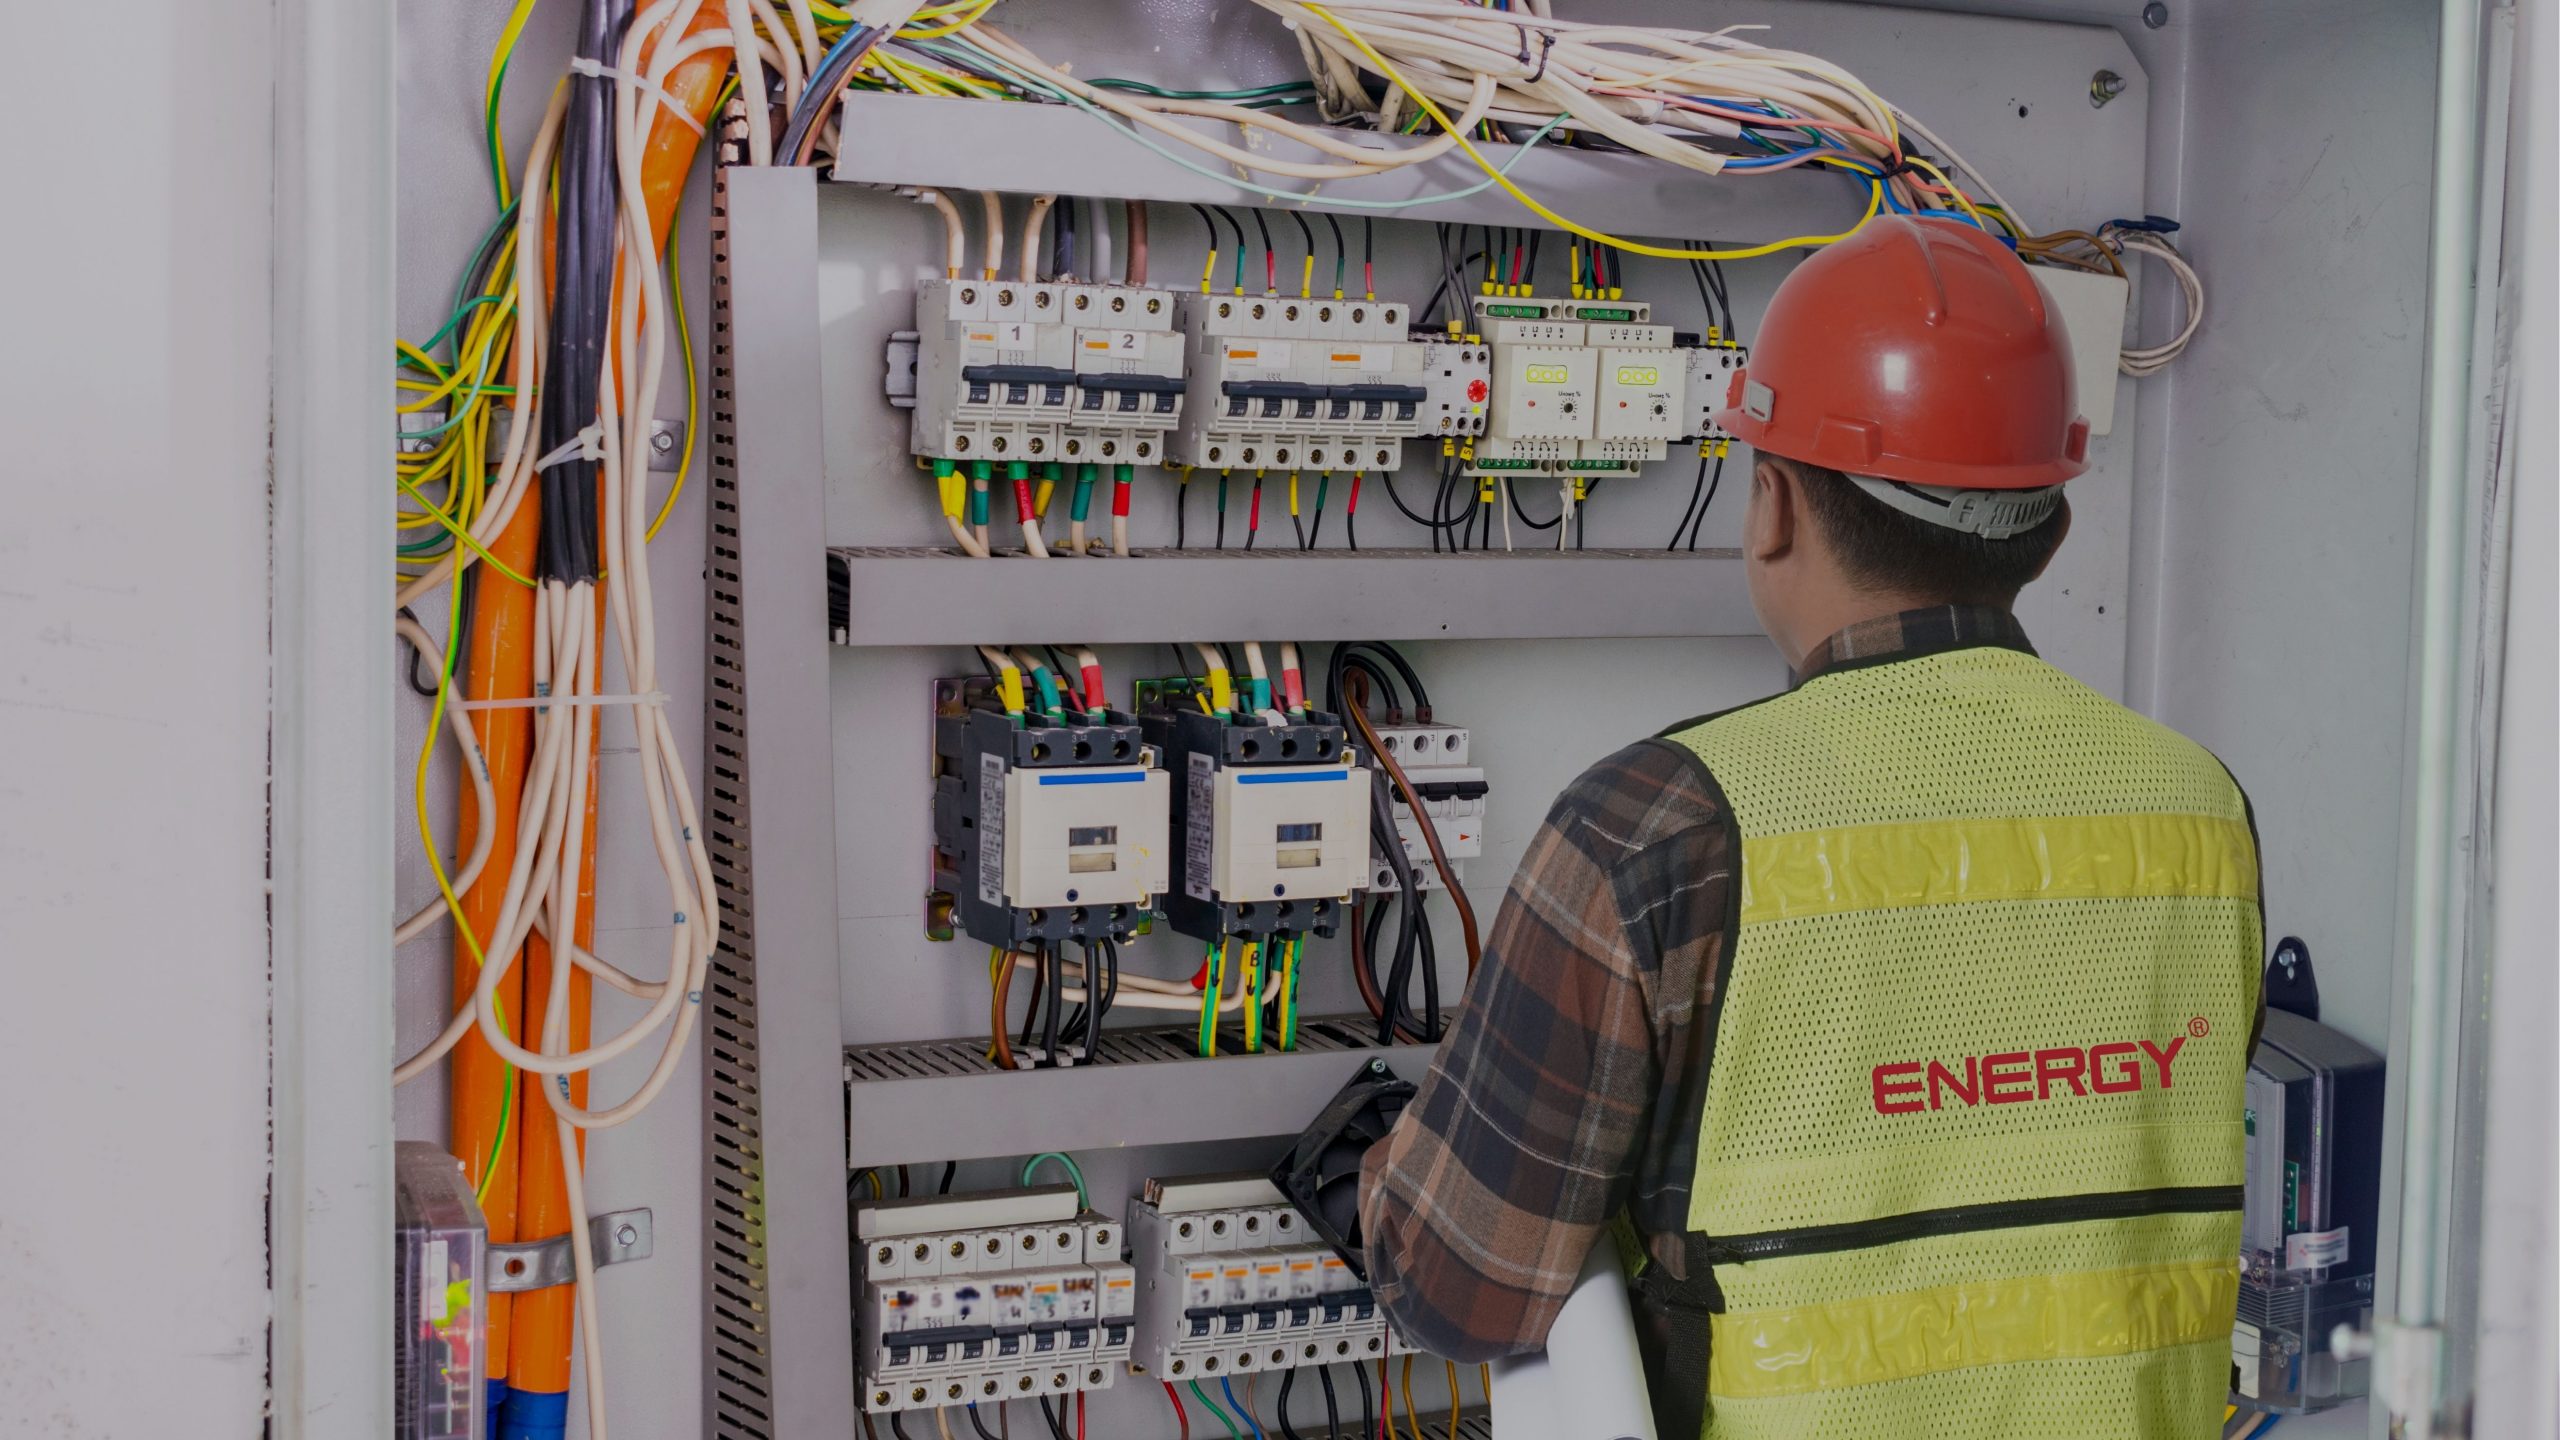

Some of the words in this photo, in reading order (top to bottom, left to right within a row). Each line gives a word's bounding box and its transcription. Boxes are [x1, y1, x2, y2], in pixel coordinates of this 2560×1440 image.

[1011, 325, 1020, 341] 1
[1122, 333, 1134, 349] 2
[1250, 950, 1261, 967] B
